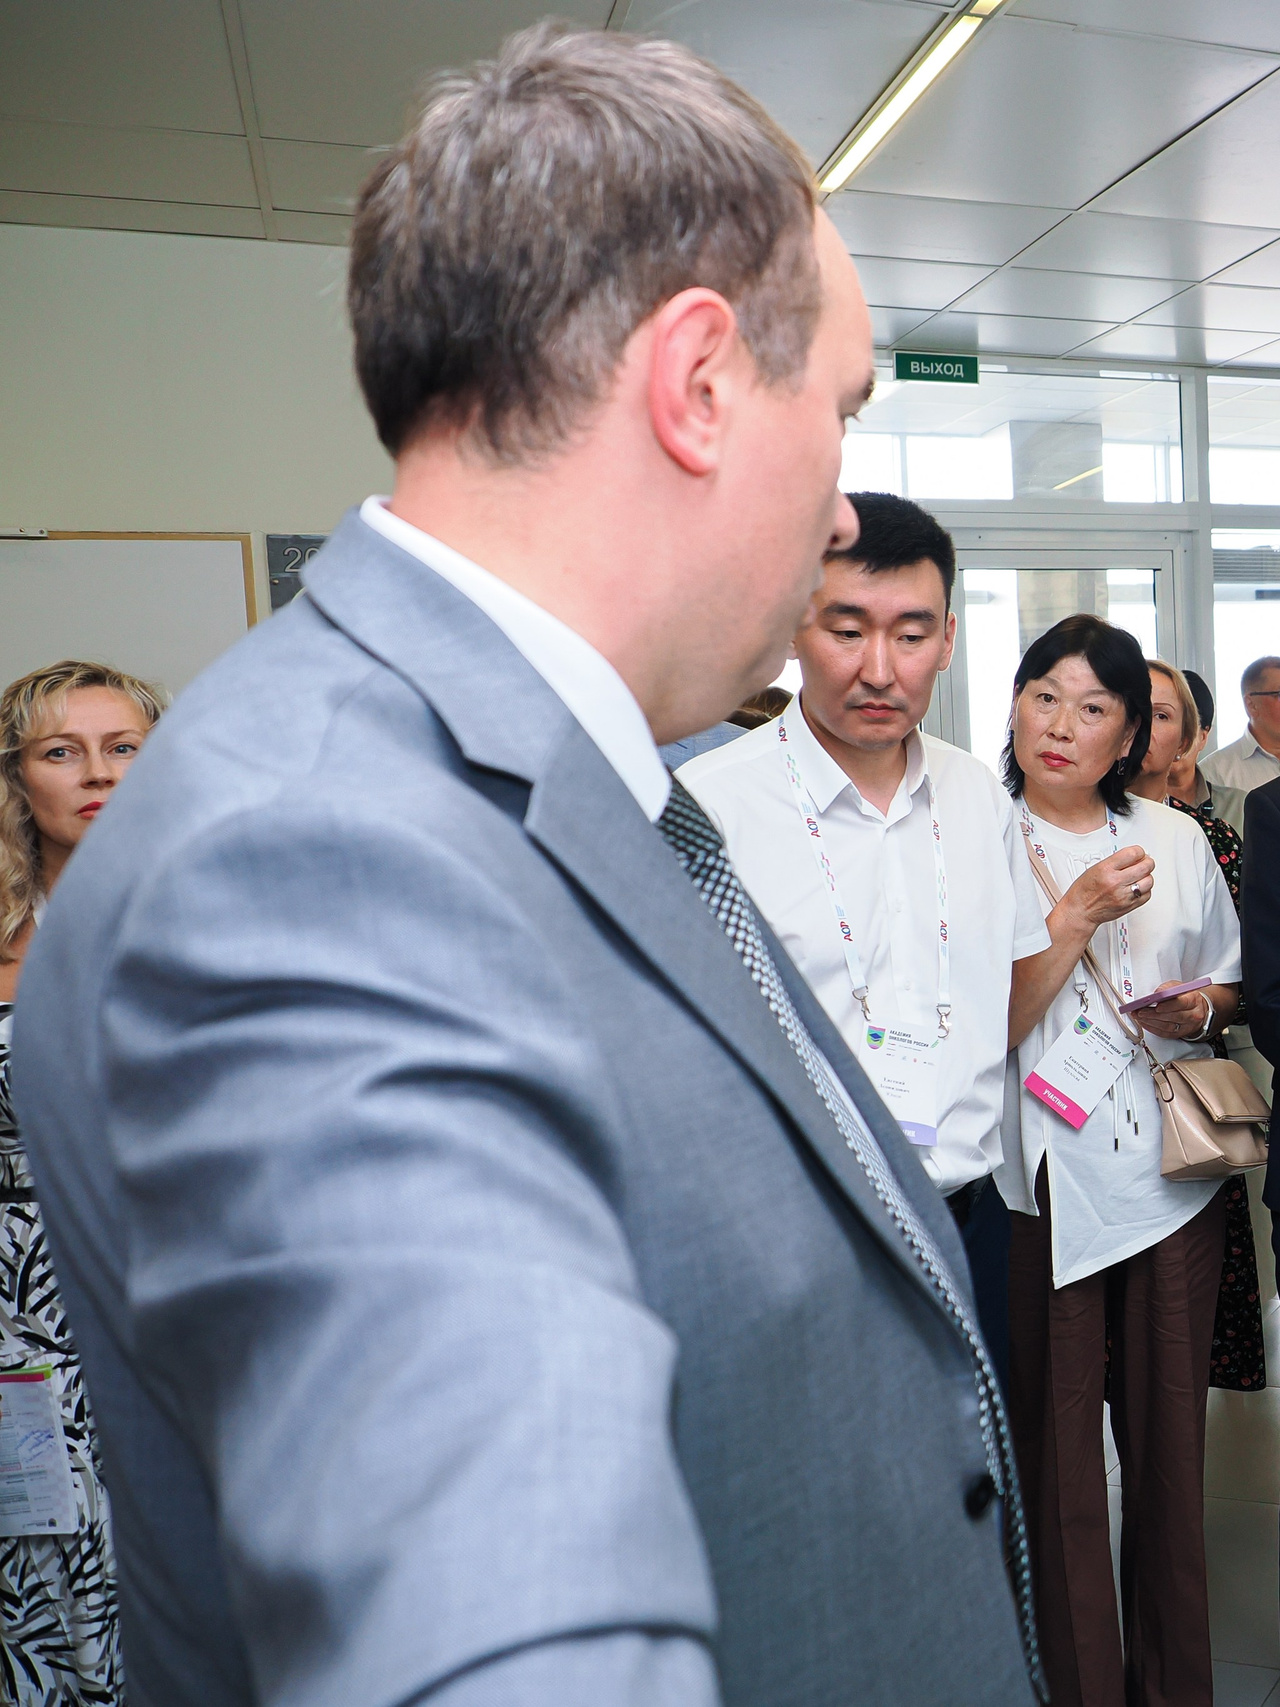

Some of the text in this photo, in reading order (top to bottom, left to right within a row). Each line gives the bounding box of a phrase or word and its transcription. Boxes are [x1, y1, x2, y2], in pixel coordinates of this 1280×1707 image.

[910, 361, 964, 378] ВЫХОД
[806, 817, 821, 837] АОР
[1033, 843, 1046, 859] АОР
[839, 921, 853, 942] АОР
[940, 920, 948, 941] АОР
[1123, 979, 1133, 998] АОР
[1043, 1088, 1068, 1111] УЧАСТНИК
